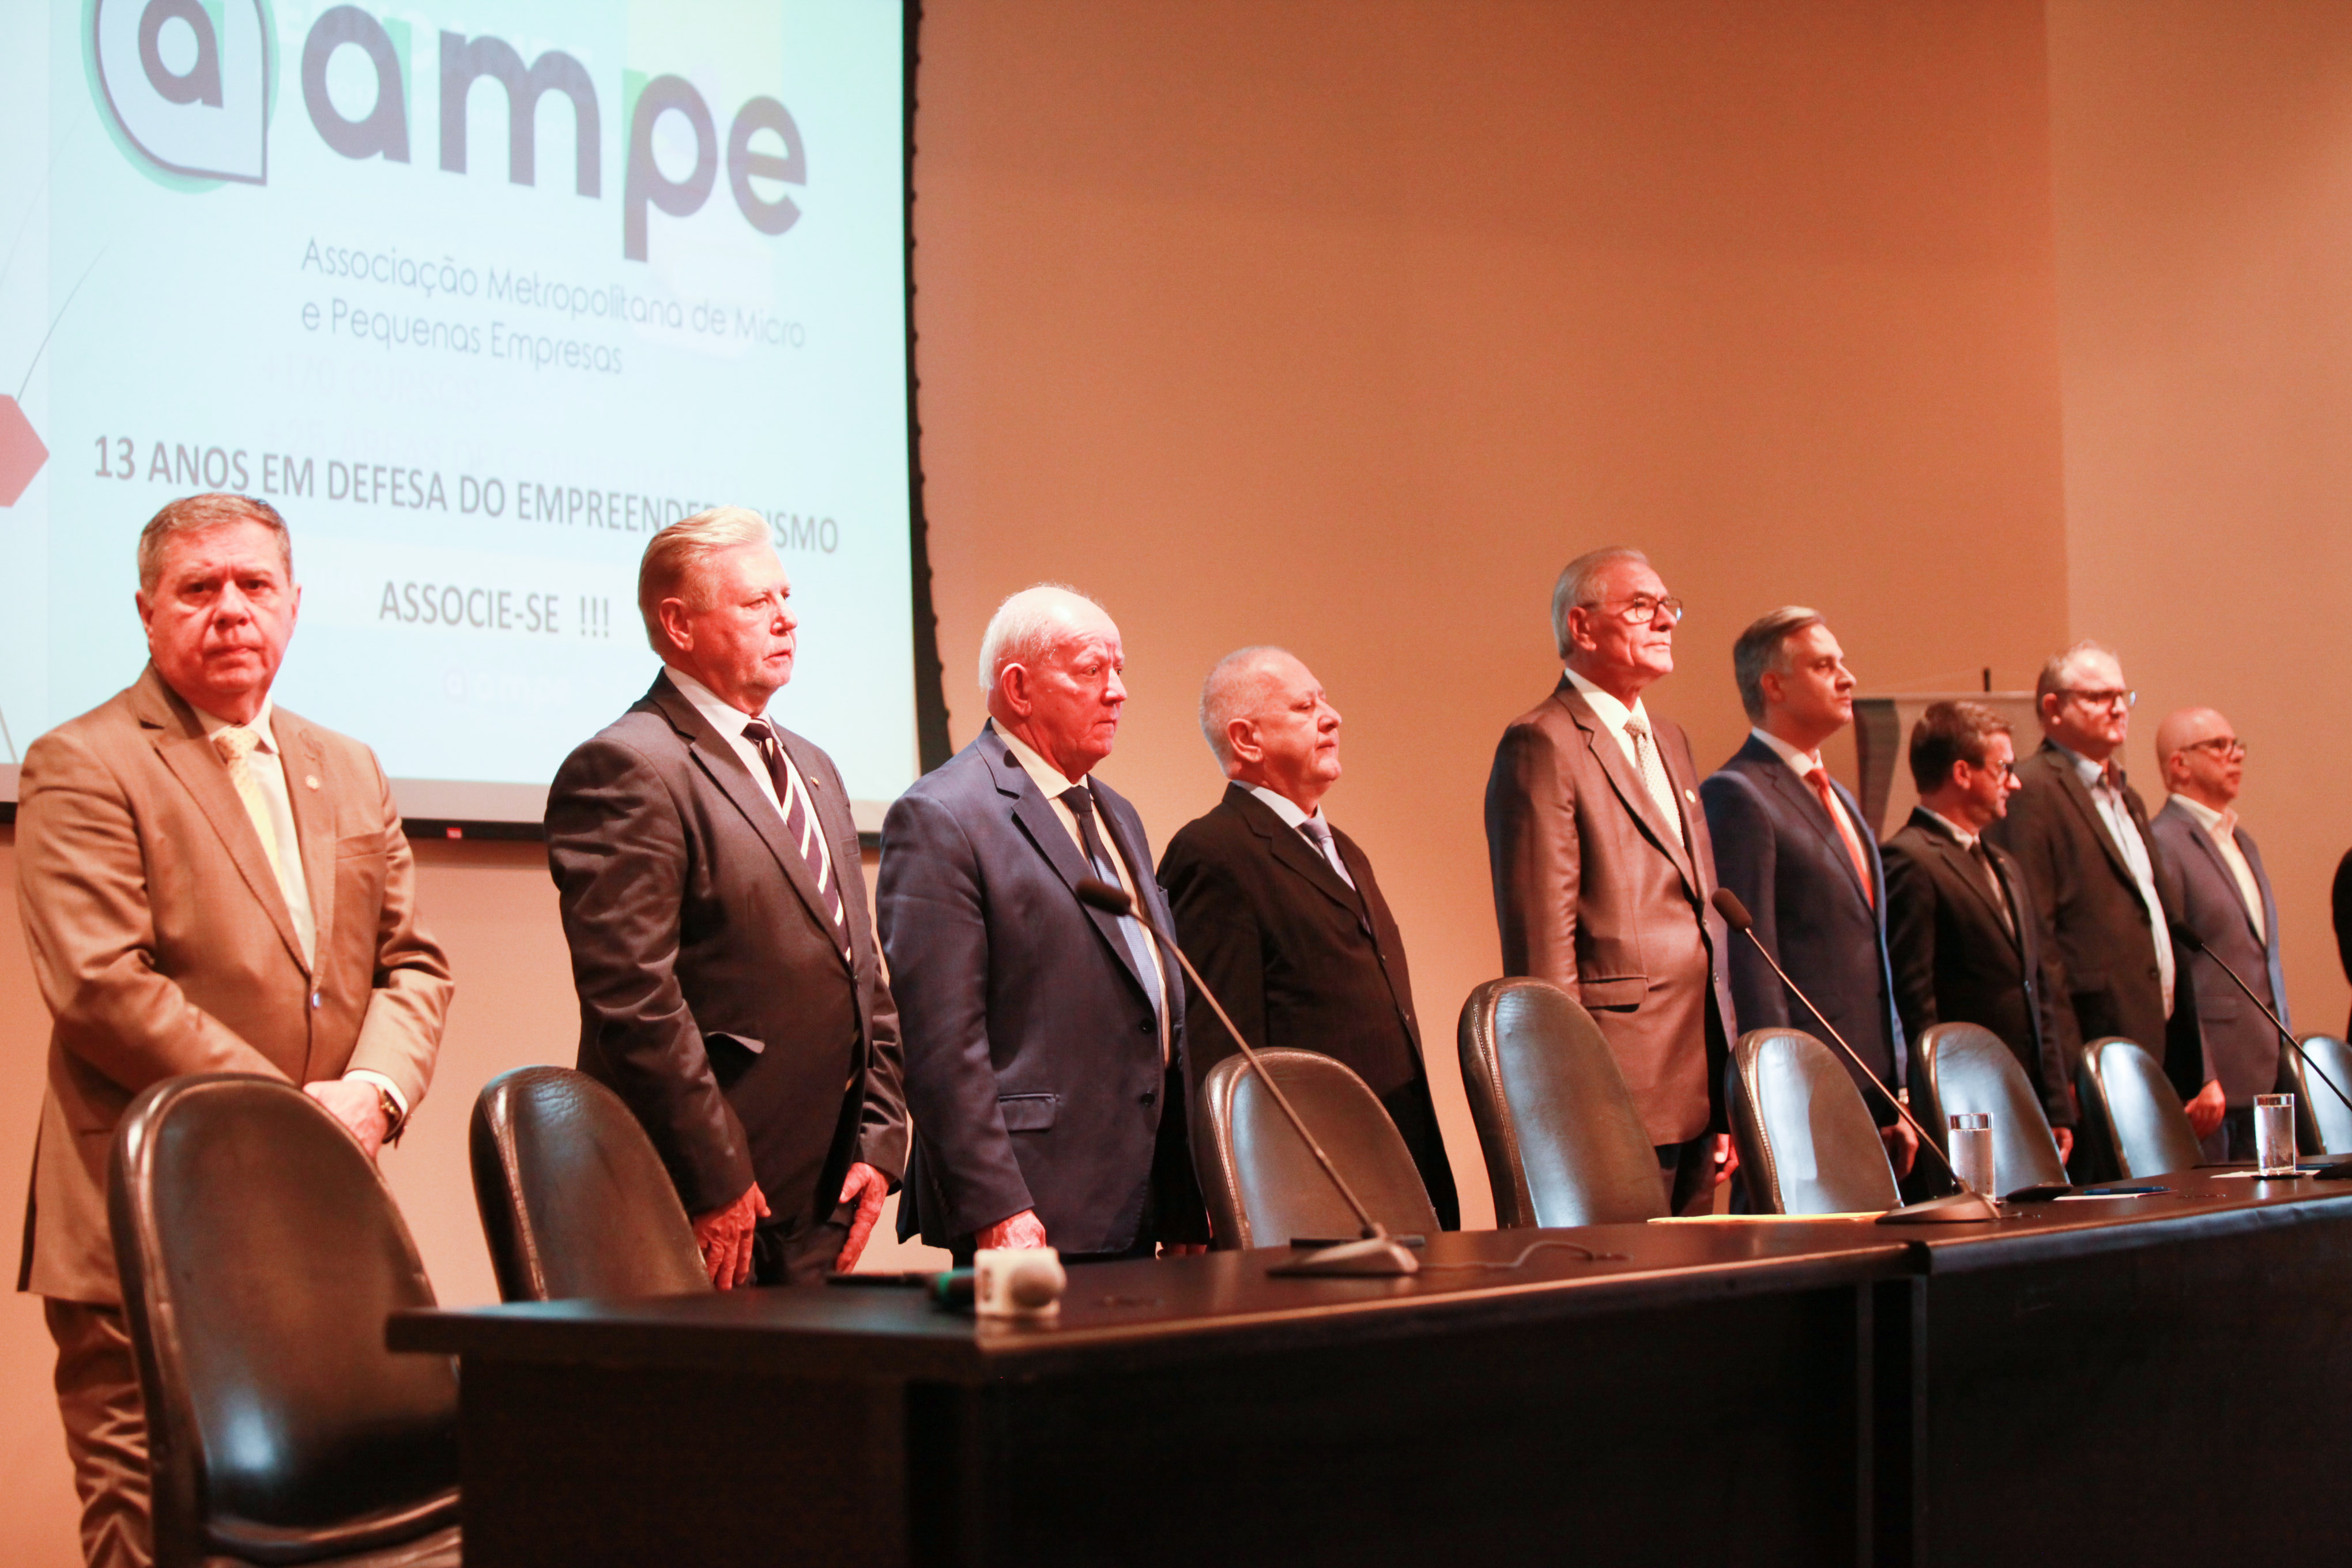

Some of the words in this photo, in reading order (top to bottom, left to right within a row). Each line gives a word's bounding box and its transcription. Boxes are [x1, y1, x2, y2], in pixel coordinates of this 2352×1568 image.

[300, 4, 806, 263] ampe
[301, 236, 478, 298] Associação
[487, 265, 683, 329] Metropolitana
[692, 299, 726, 336] de
[734, 307, 806, 349] Micro
[302, 301, 320, 331] e
[333, 297, 481, 353] Pequenas
[492, 321, 623, 375] Empresas
[95, 435, 136, 481] 13
[148, 441, 250, 492] ANOS
[263, 453, 315, 499] EM
[328, 459, 448, 512] DEFESA
[460, 474, 506, 518] DO
[379, 581, 560, 634] ASSOCIE-SE
